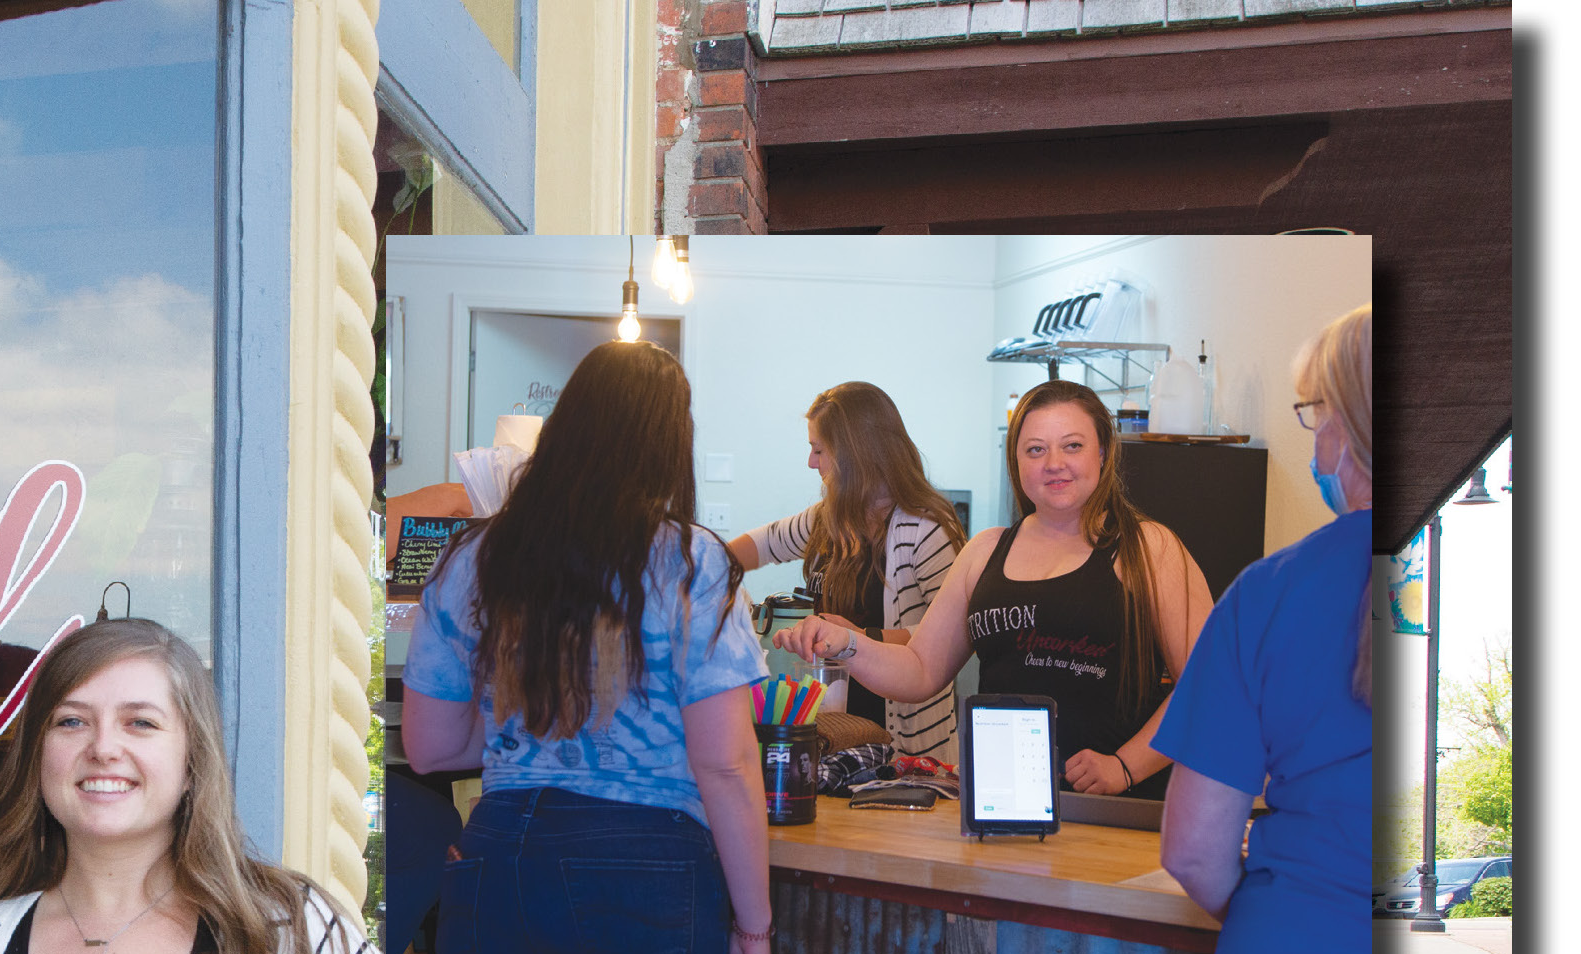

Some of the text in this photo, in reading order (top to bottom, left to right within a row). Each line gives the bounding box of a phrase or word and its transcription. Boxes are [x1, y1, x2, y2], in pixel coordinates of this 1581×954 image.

[403, 517, 449, 545] Bubbly
[1017, 628, 1116, 656] Uncorked
[1025, 651, 1107, 680] Cheers to new beginnings
[767, 752, 790, 764] 24
